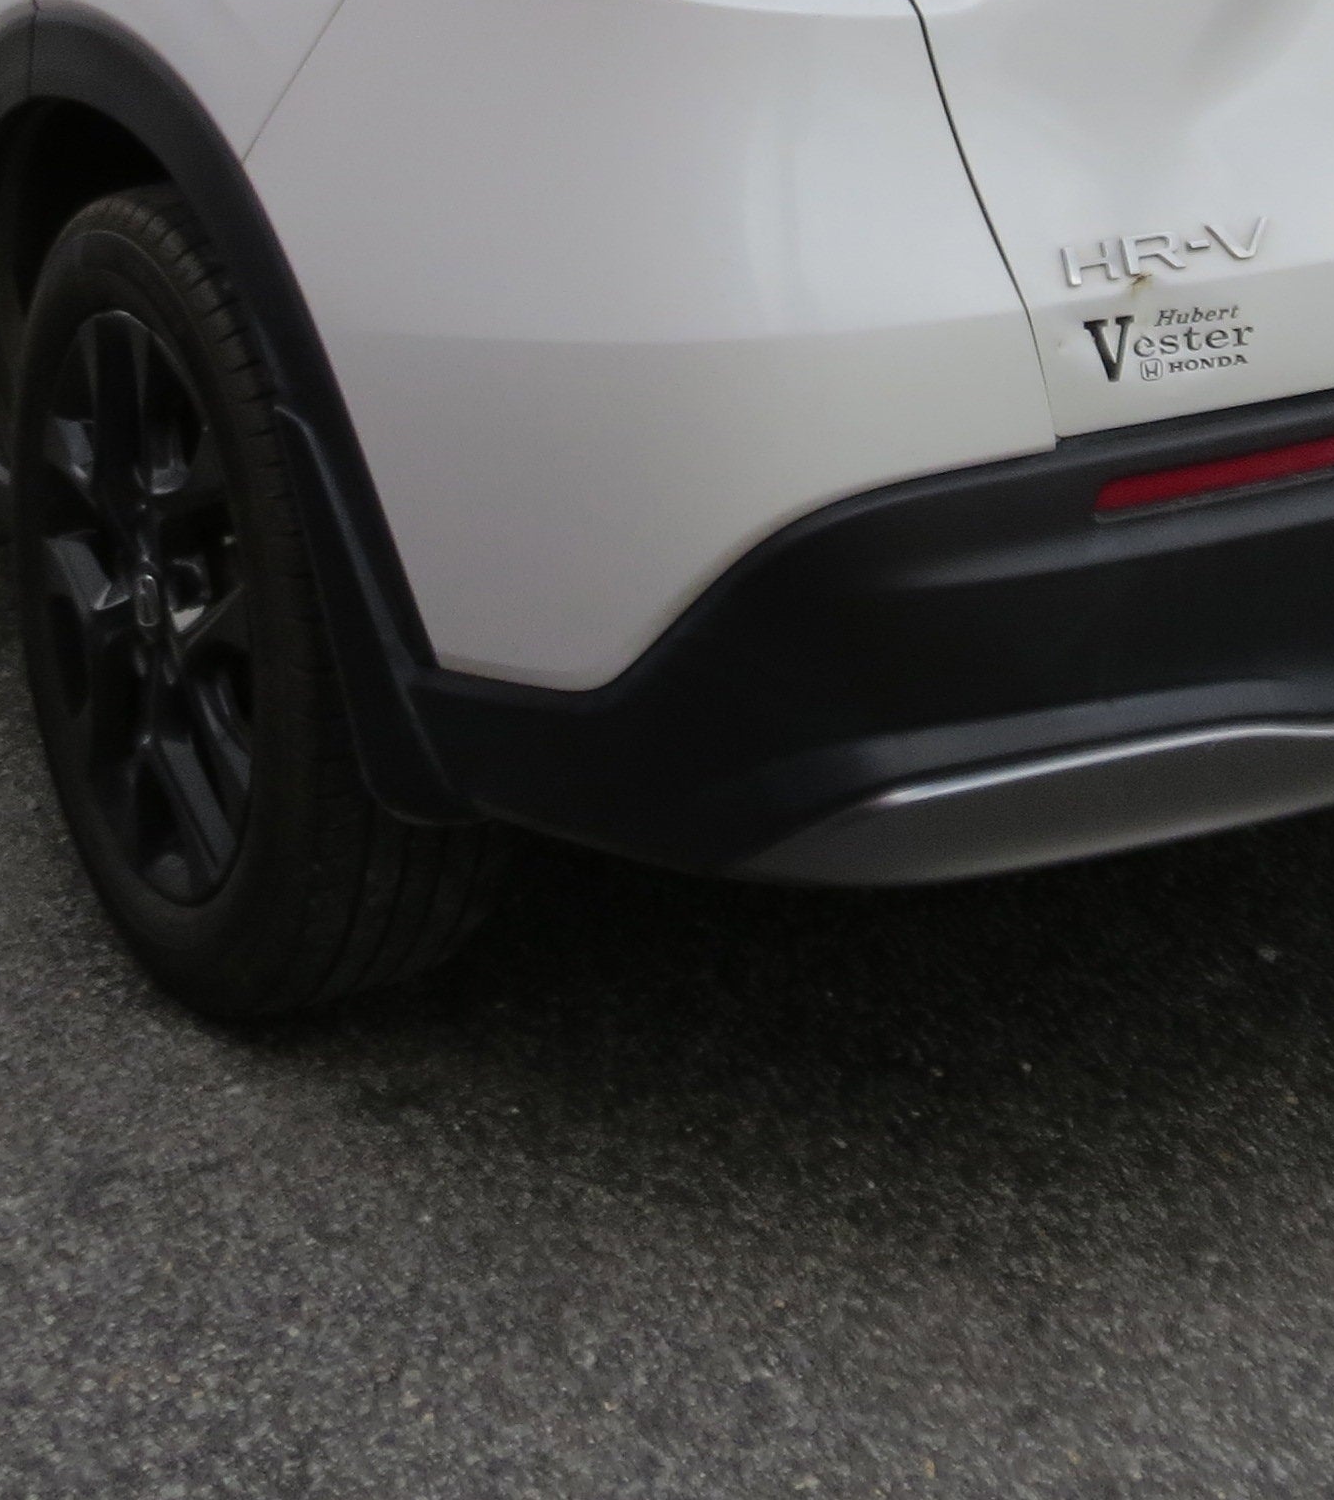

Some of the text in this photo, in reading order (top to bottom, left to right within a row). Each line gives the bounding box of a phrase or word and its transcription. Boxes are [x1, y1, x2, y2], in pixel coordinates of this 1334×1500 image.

[1061, 216, 1267, 288] HR-V
[1154, 305, 1240, 328] Hubert
[1083, 315, 1255, 383] Vester
[1168, 353, 1249, 374] HONDA
